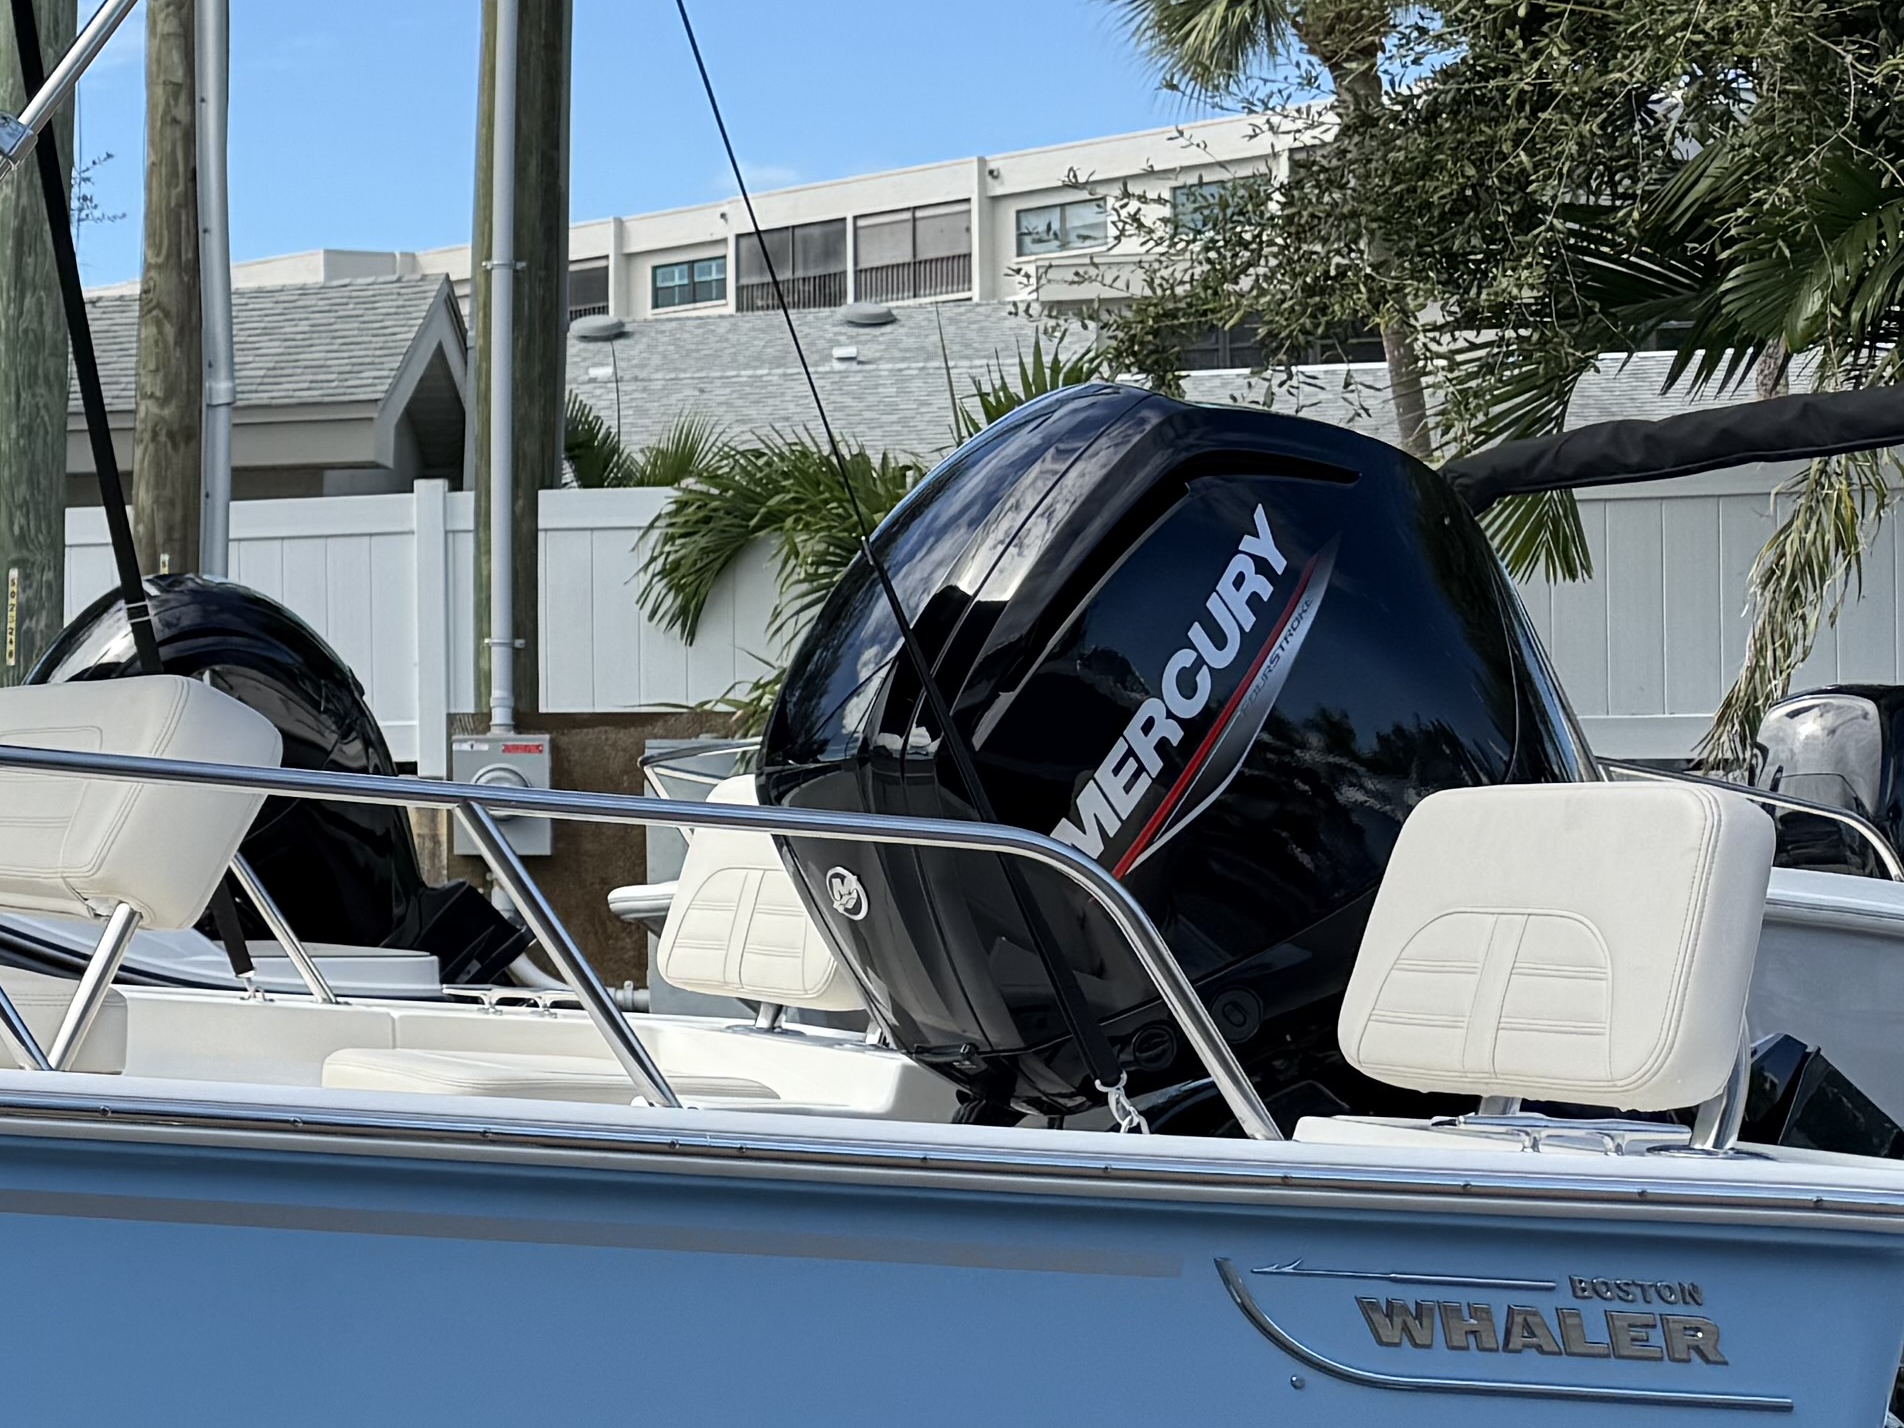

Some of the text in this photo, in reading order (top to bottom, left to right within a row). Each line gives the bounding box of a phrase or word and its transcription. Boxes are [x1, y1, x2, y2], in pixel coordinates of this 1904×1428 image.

[1050, 503, 1287, 859] MERCURY
[1568, 1274, 1704, 1307] BOSTON
[1354, 1295, 1729, 1366] WHALER
